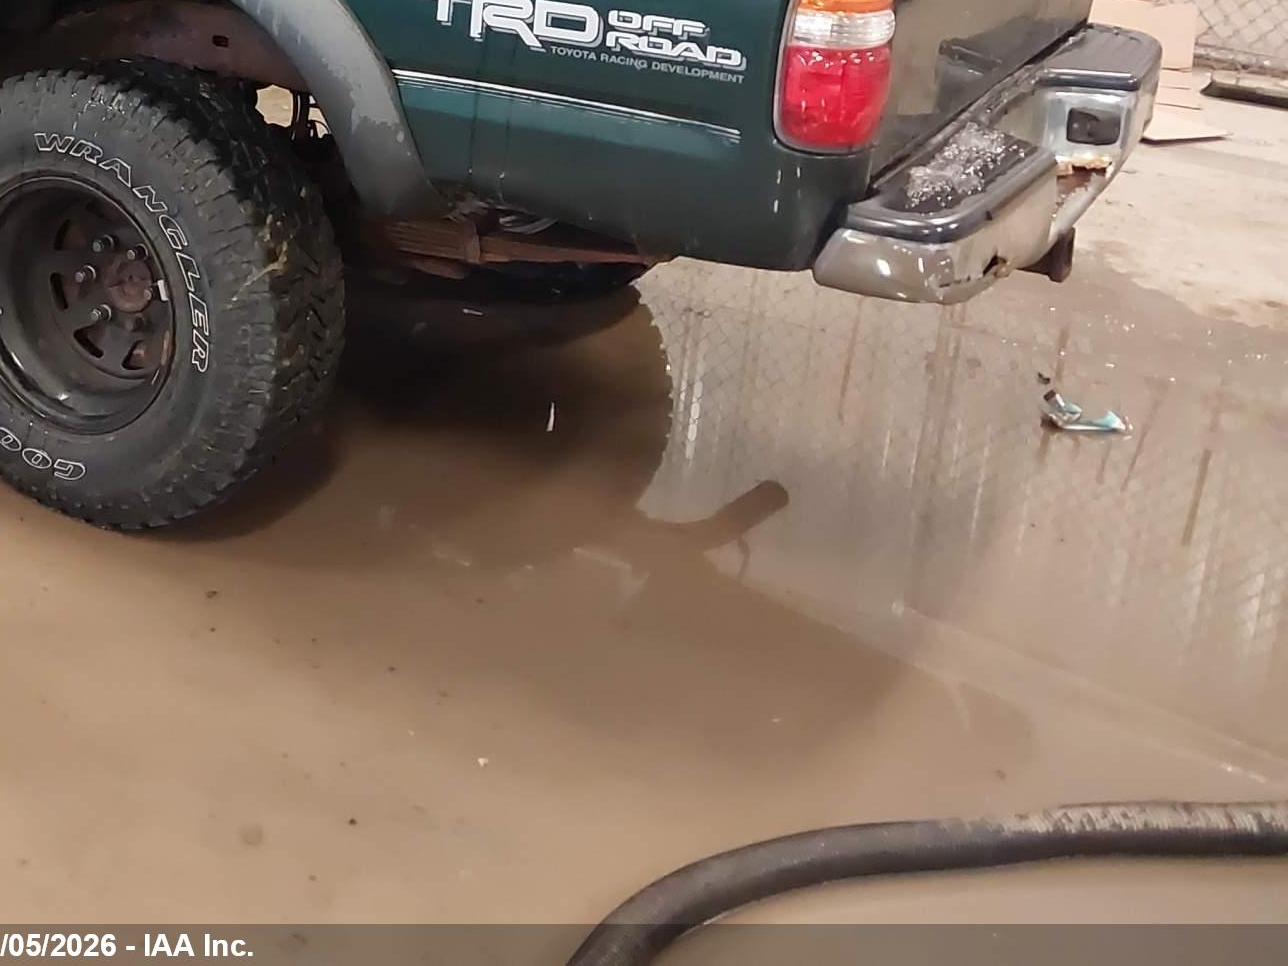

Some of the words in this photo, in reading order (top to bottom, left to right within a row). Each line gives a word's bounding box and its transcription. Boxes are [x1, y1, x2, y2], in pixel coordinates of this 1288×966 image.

[608, 10, 710, 39] OFF
[550, 46, 597, 61] TOYOTA
[600, 53, 648, 70] RACING
[651, 62, 745, 84] DEVELOPMENT
[605, 31, 747, 71] ROAD
[34, 132, 209, 372] WRANGLER
